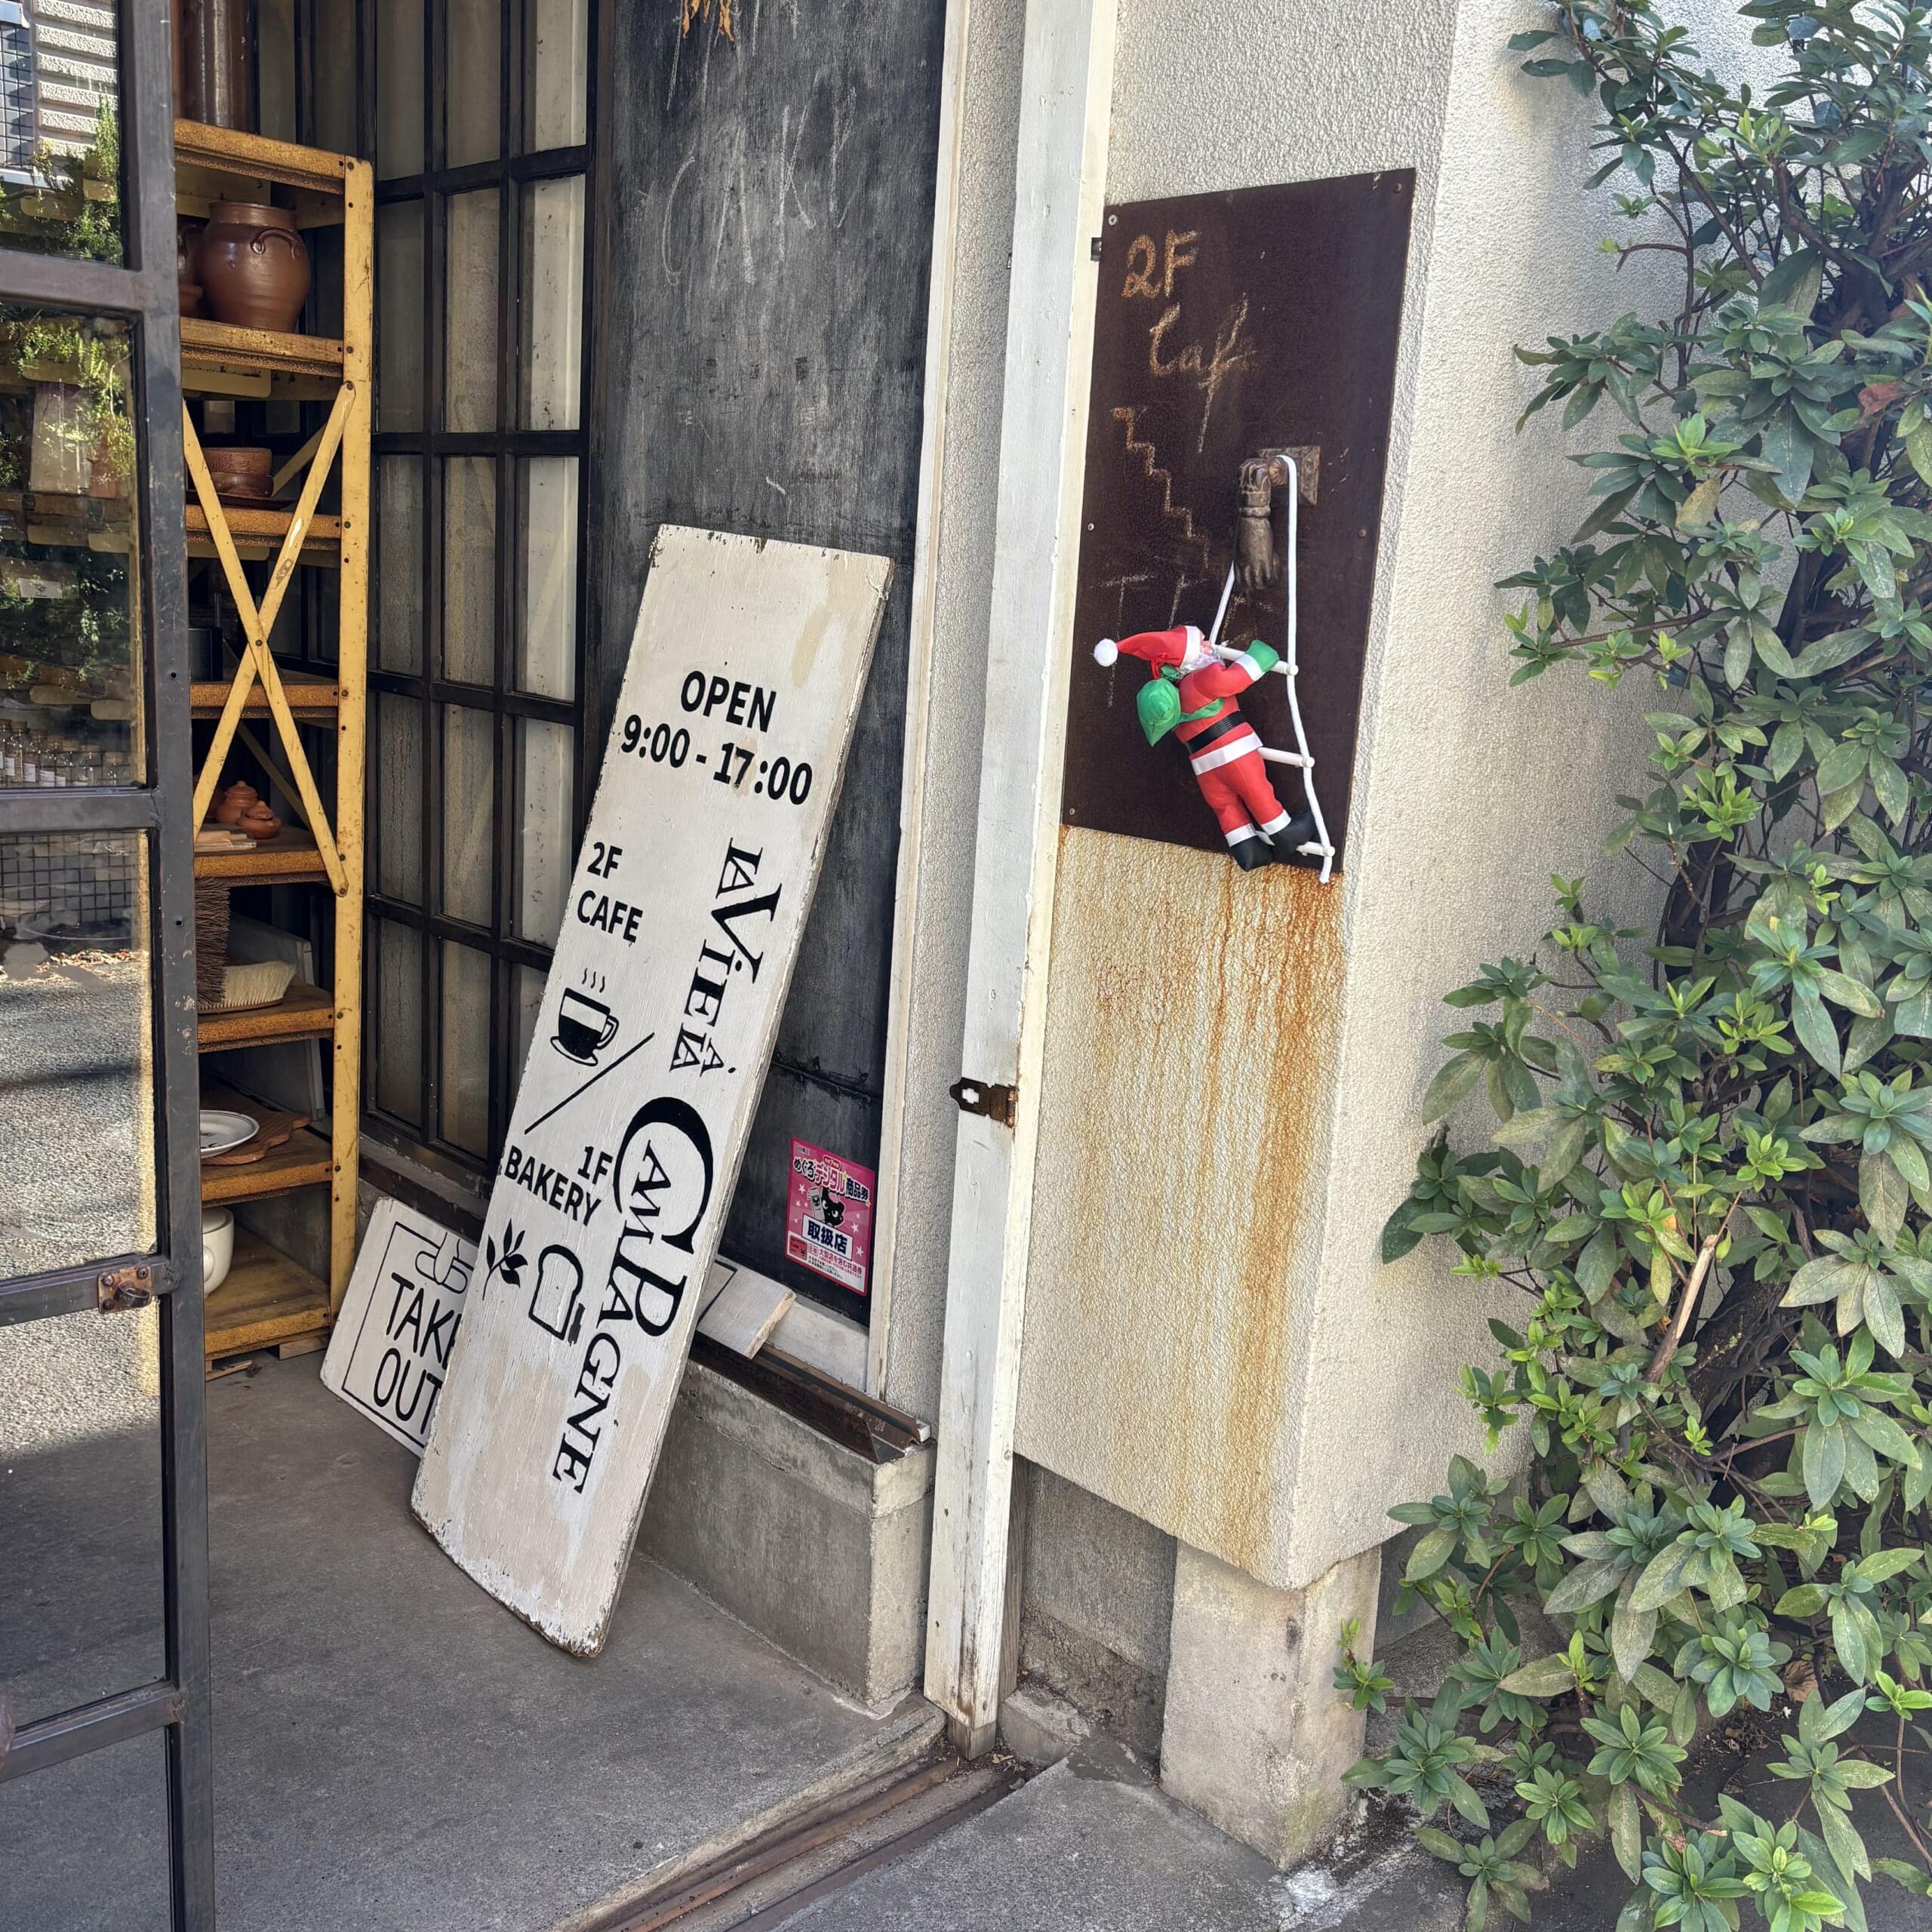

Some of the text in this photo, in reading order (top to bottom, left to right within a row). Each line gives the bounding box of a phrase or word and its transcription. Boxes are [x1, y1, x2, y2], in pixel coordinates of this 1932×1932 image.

[1121, 229, 1202, 298] 2F
[681, 671, 777, 732] OPEN
[587, 841, 623, 879] 2F
[577, 891, 643, 943] CAFE
[504, 1145, 601, 1226] BAKERY
[577, 1146, 614, 1185] 1F
[808, 1220, 848, 1254] 取扱店
[552, 1097, 714, 1494] CAMPAGNE
[373, 1348, 443, 1435] OUT
